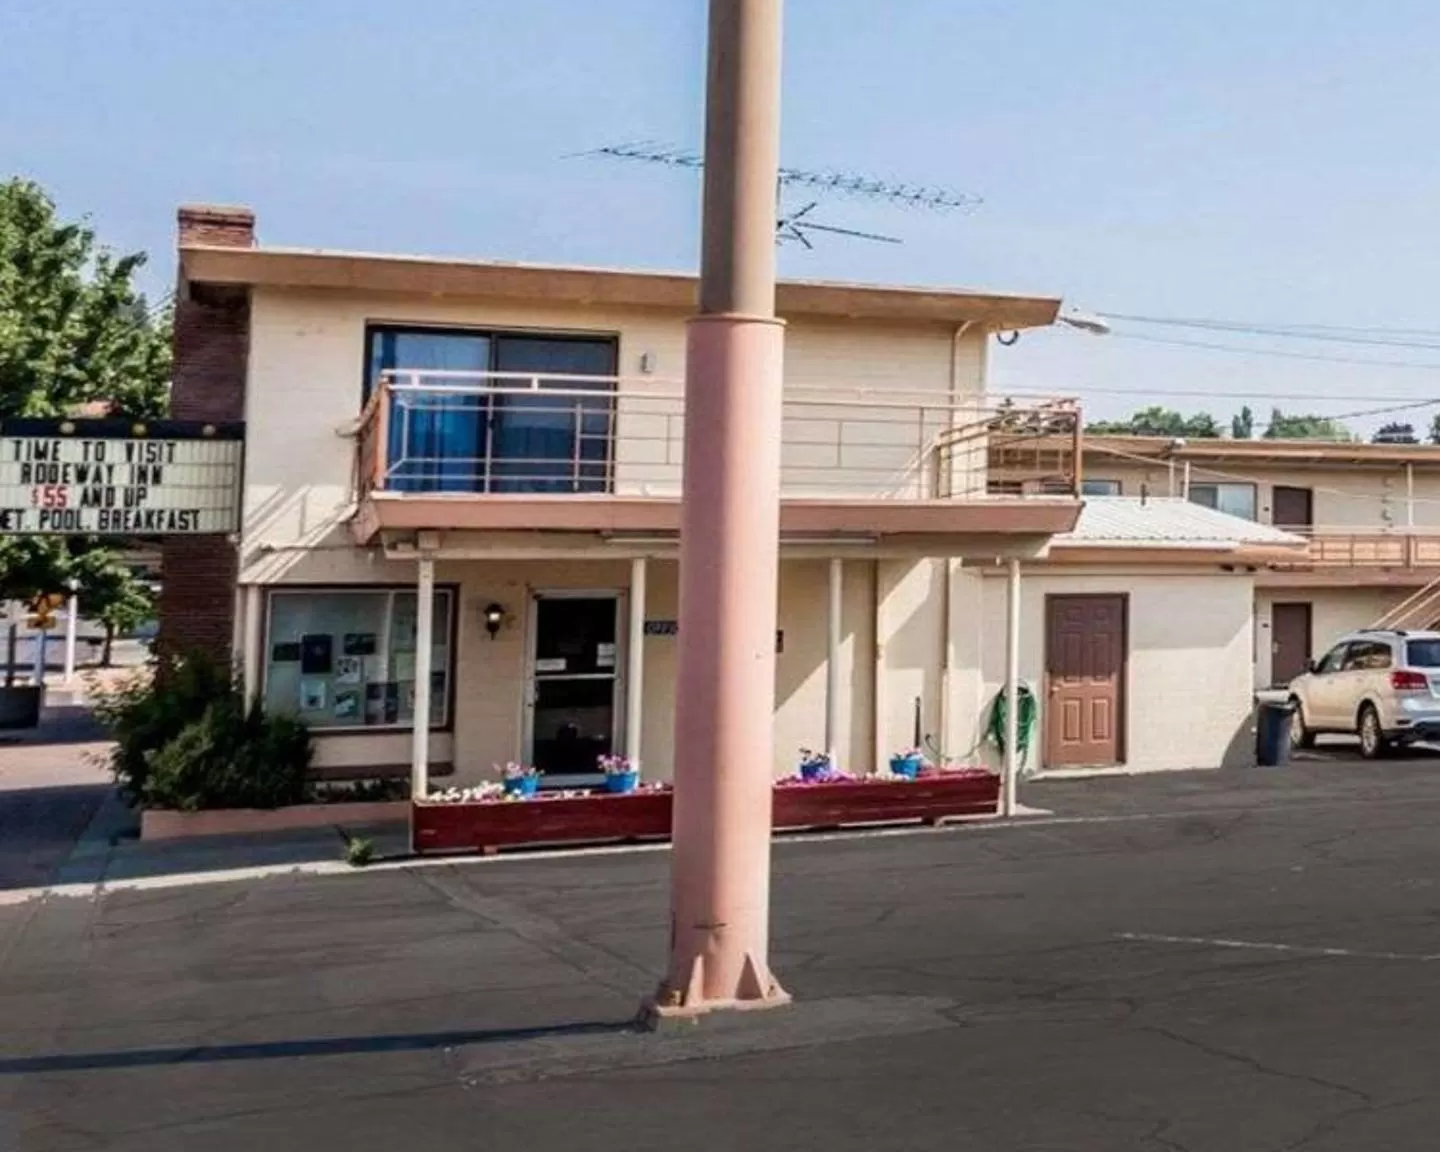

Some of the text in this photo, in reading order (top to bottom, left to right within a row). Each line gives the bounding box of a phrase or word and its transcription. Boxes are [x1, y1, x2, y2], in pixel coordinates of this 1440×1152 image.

[13, 439, 177, 464] TIME TO VISIT
[20, 462, 163, 486] RODEWAY INN
[30, 486, 148, 508] $55 AND UP
[99, 509, 201, 531] BREAKFAST
